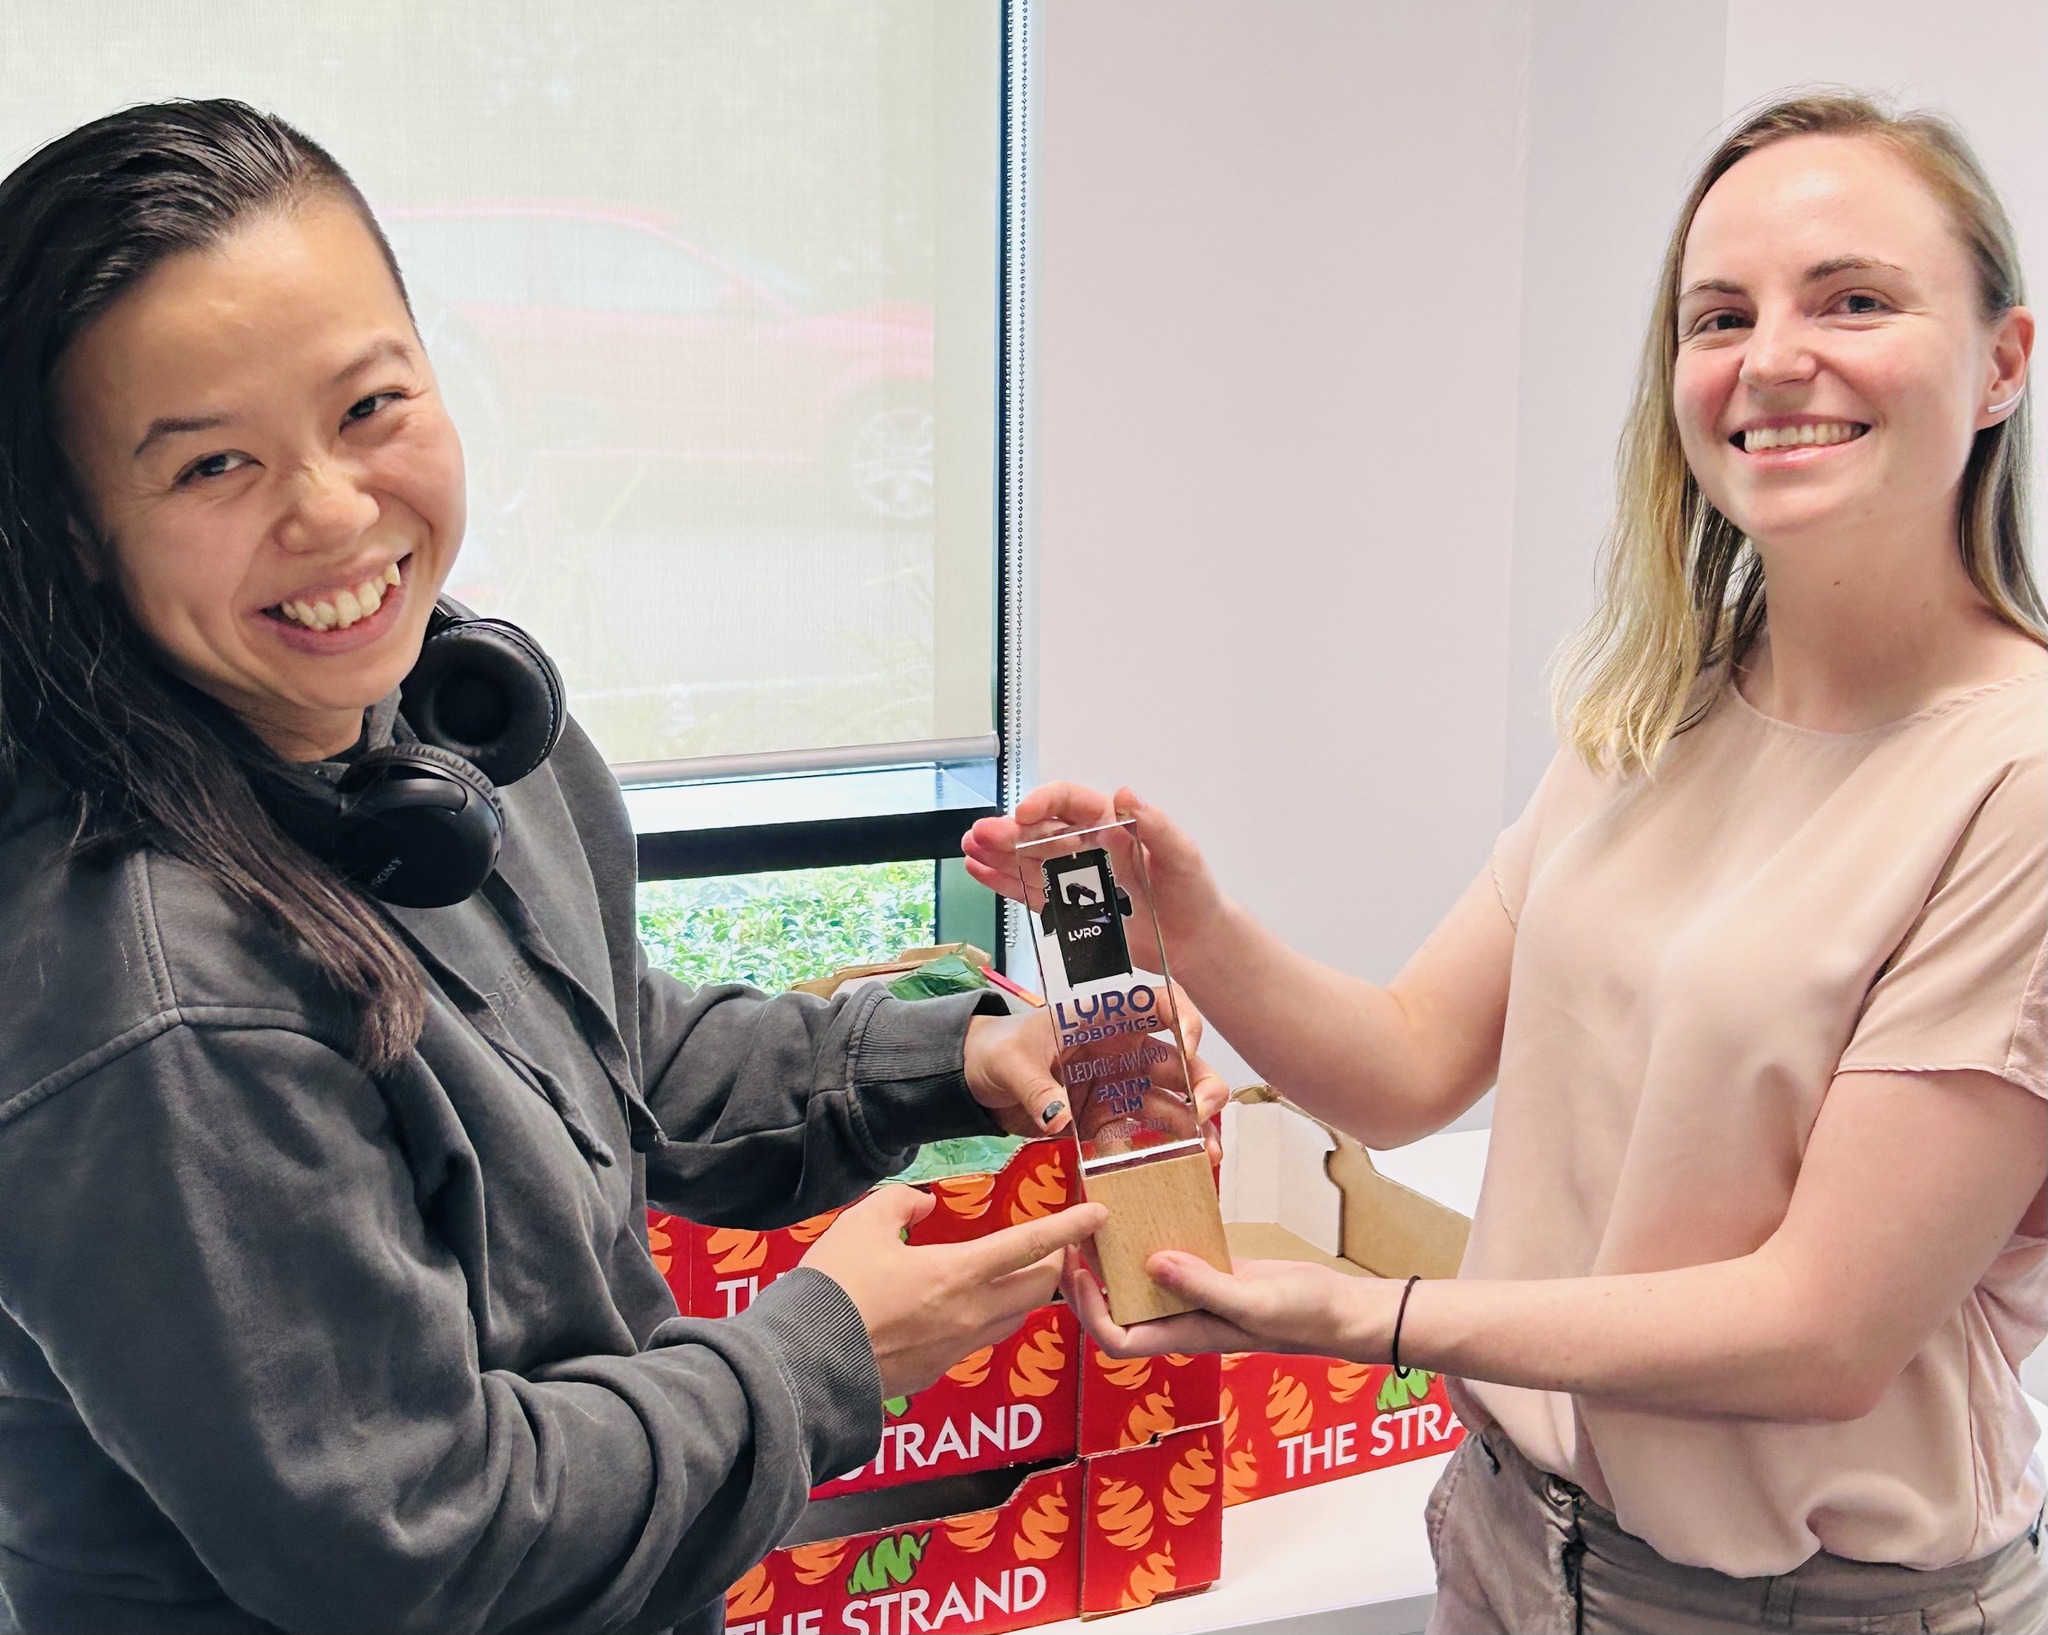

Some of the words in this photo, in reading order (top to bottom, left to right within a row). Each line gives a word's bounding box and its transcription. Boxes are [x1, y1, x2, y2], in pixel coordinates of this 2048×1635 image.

[1068, 925, 1102, 942] LYRO
[1056, 984, 1156, 1031] LYRO
[1063, 1015, 1158, 1047] ROBOTICS
[1119, 1046, 1168, 1073] AWARD
[1096, 1076, 1152, 1102] FAITH
[1111, 1096, 1144, 1115] LIM
[838, 1404, 1042, 1481] TRAND
[1277, 1422, 1357, 1479] THE
[1370, 1403, 1463, 1457] STRA
[842, 1566, 1046, 1635] STRAND
